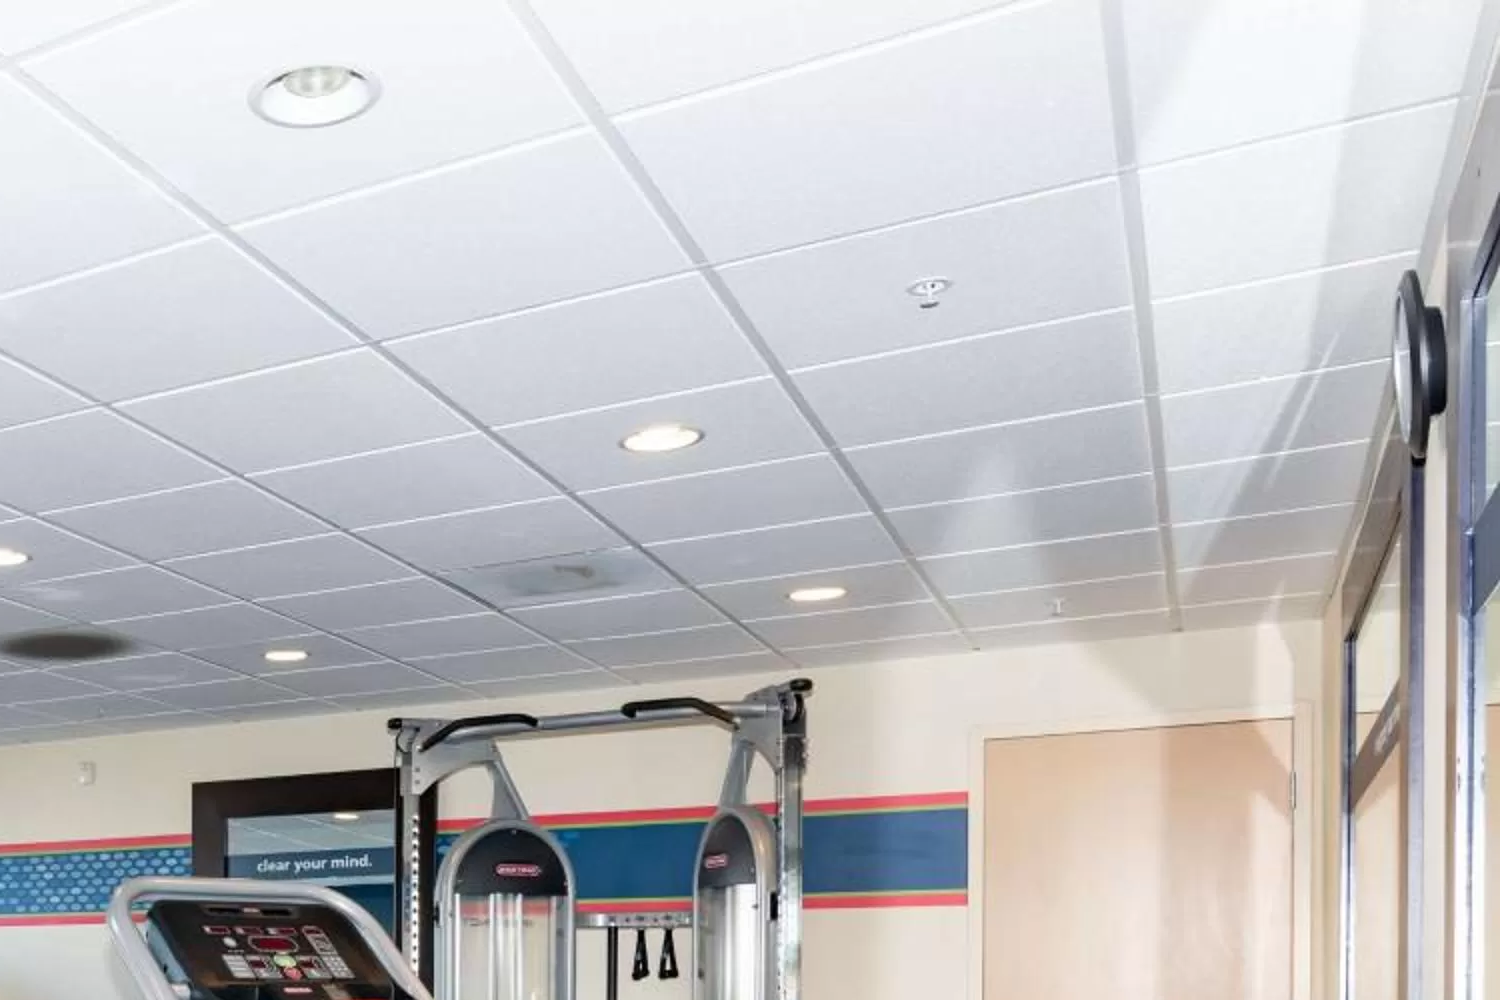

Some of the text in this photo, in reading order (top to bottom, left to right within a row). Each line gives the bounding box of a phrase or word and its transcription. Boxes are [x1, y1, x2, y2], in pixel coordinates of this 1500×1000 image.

[257, 854, 373, 874] clear your mind.
